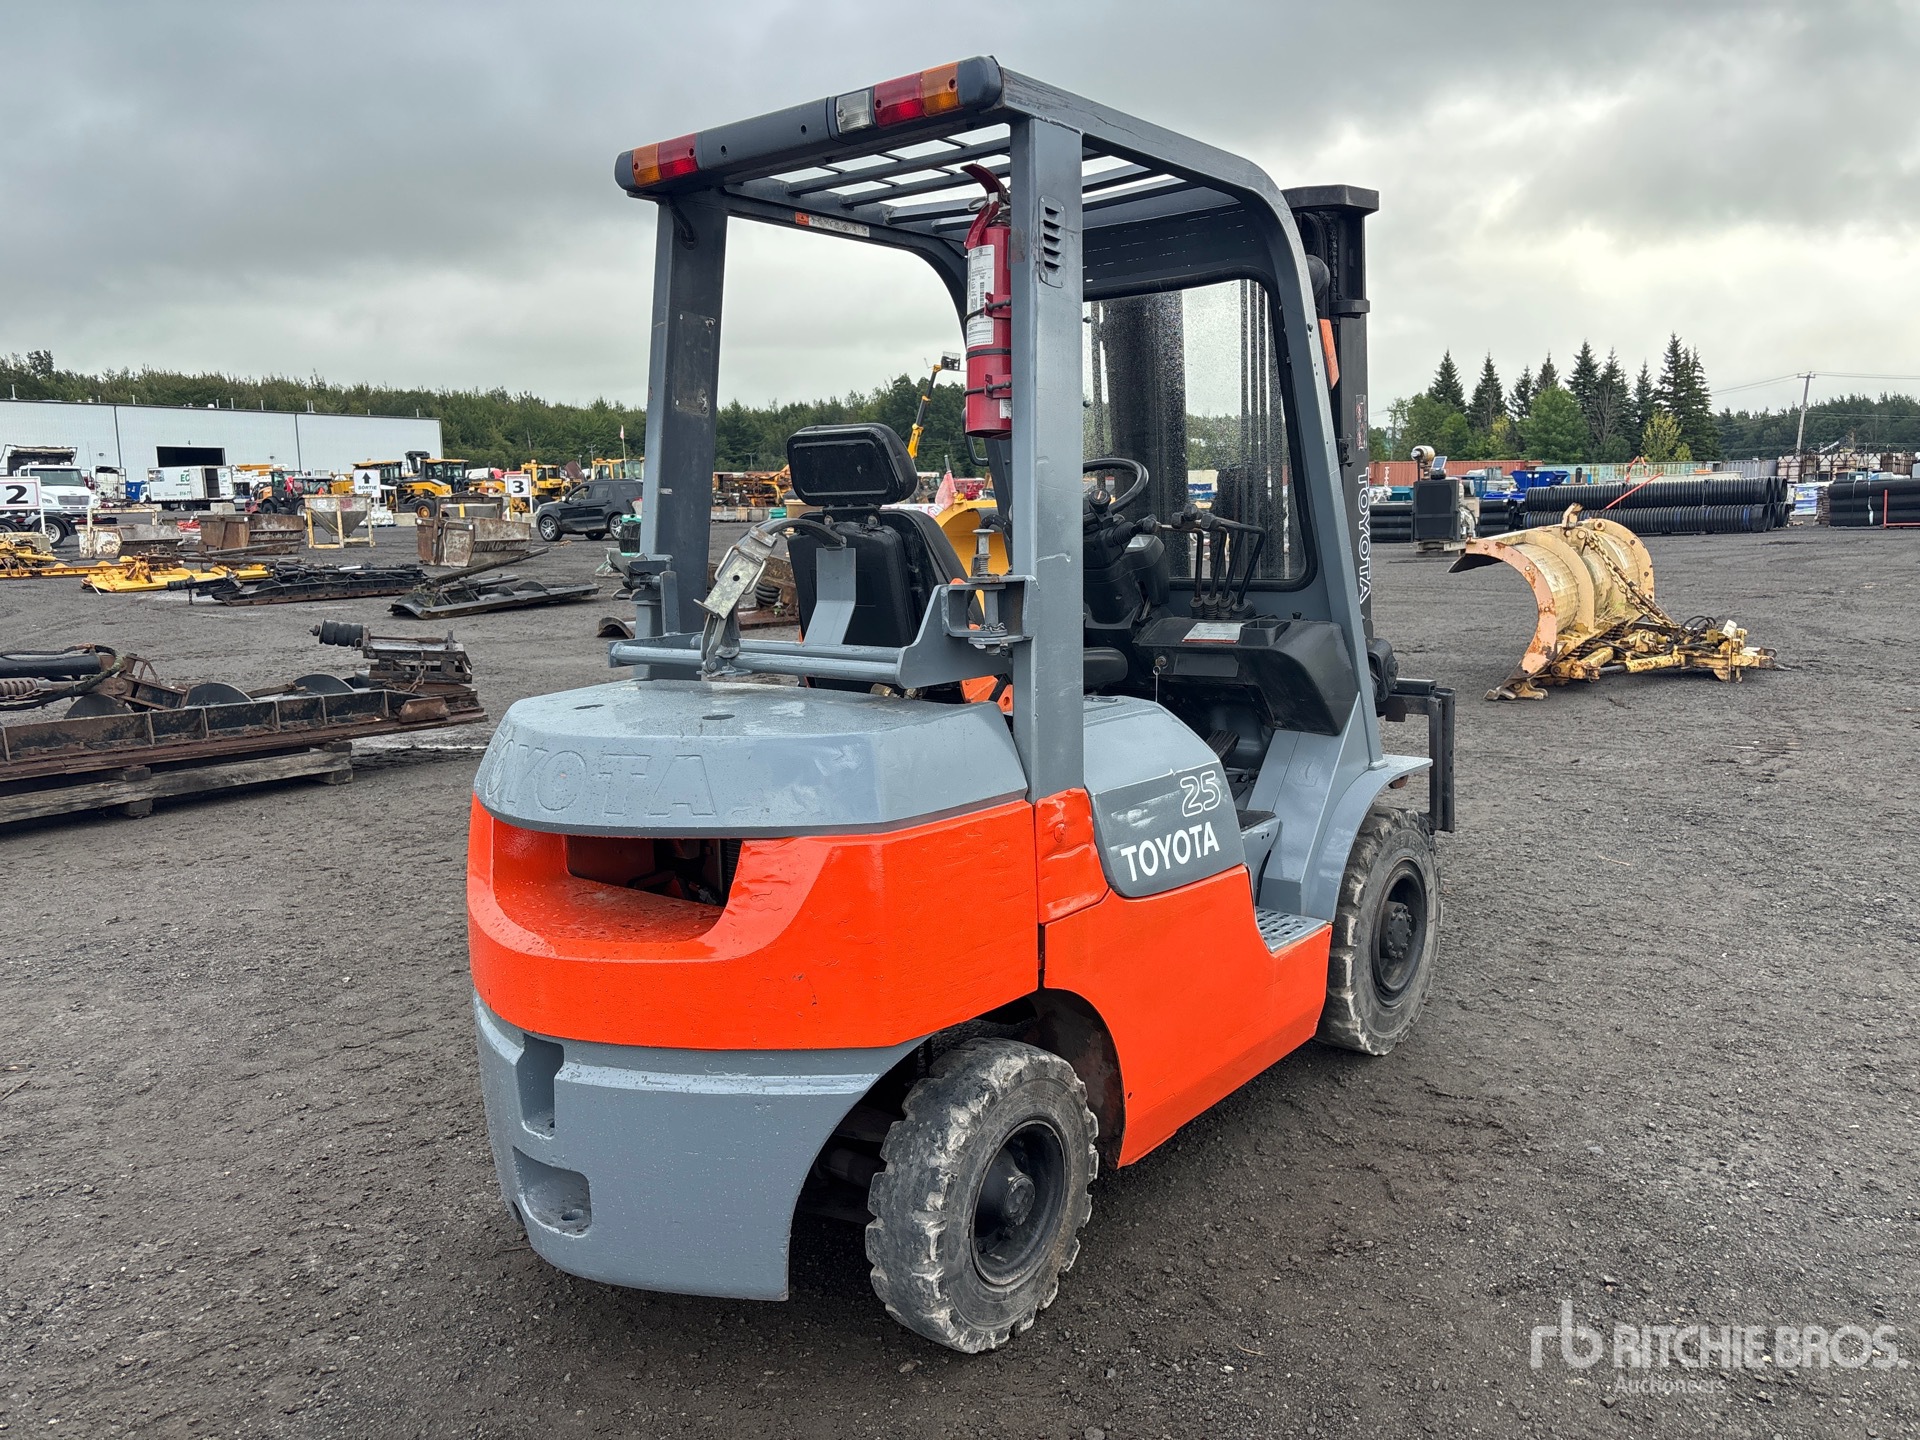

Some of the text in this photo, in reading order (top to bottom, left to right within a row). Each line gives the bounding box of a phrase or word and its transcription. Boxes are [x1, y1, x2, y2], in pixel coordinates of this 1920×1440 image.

[5, 485, 28, 504] 2
[513, 481, 525, 493] 3
[1358, 466, 1370, 604] TOYOTA
[1180, 770, 1221, 817] 25
[1120, 821, 1220, 882] TOYOTA
